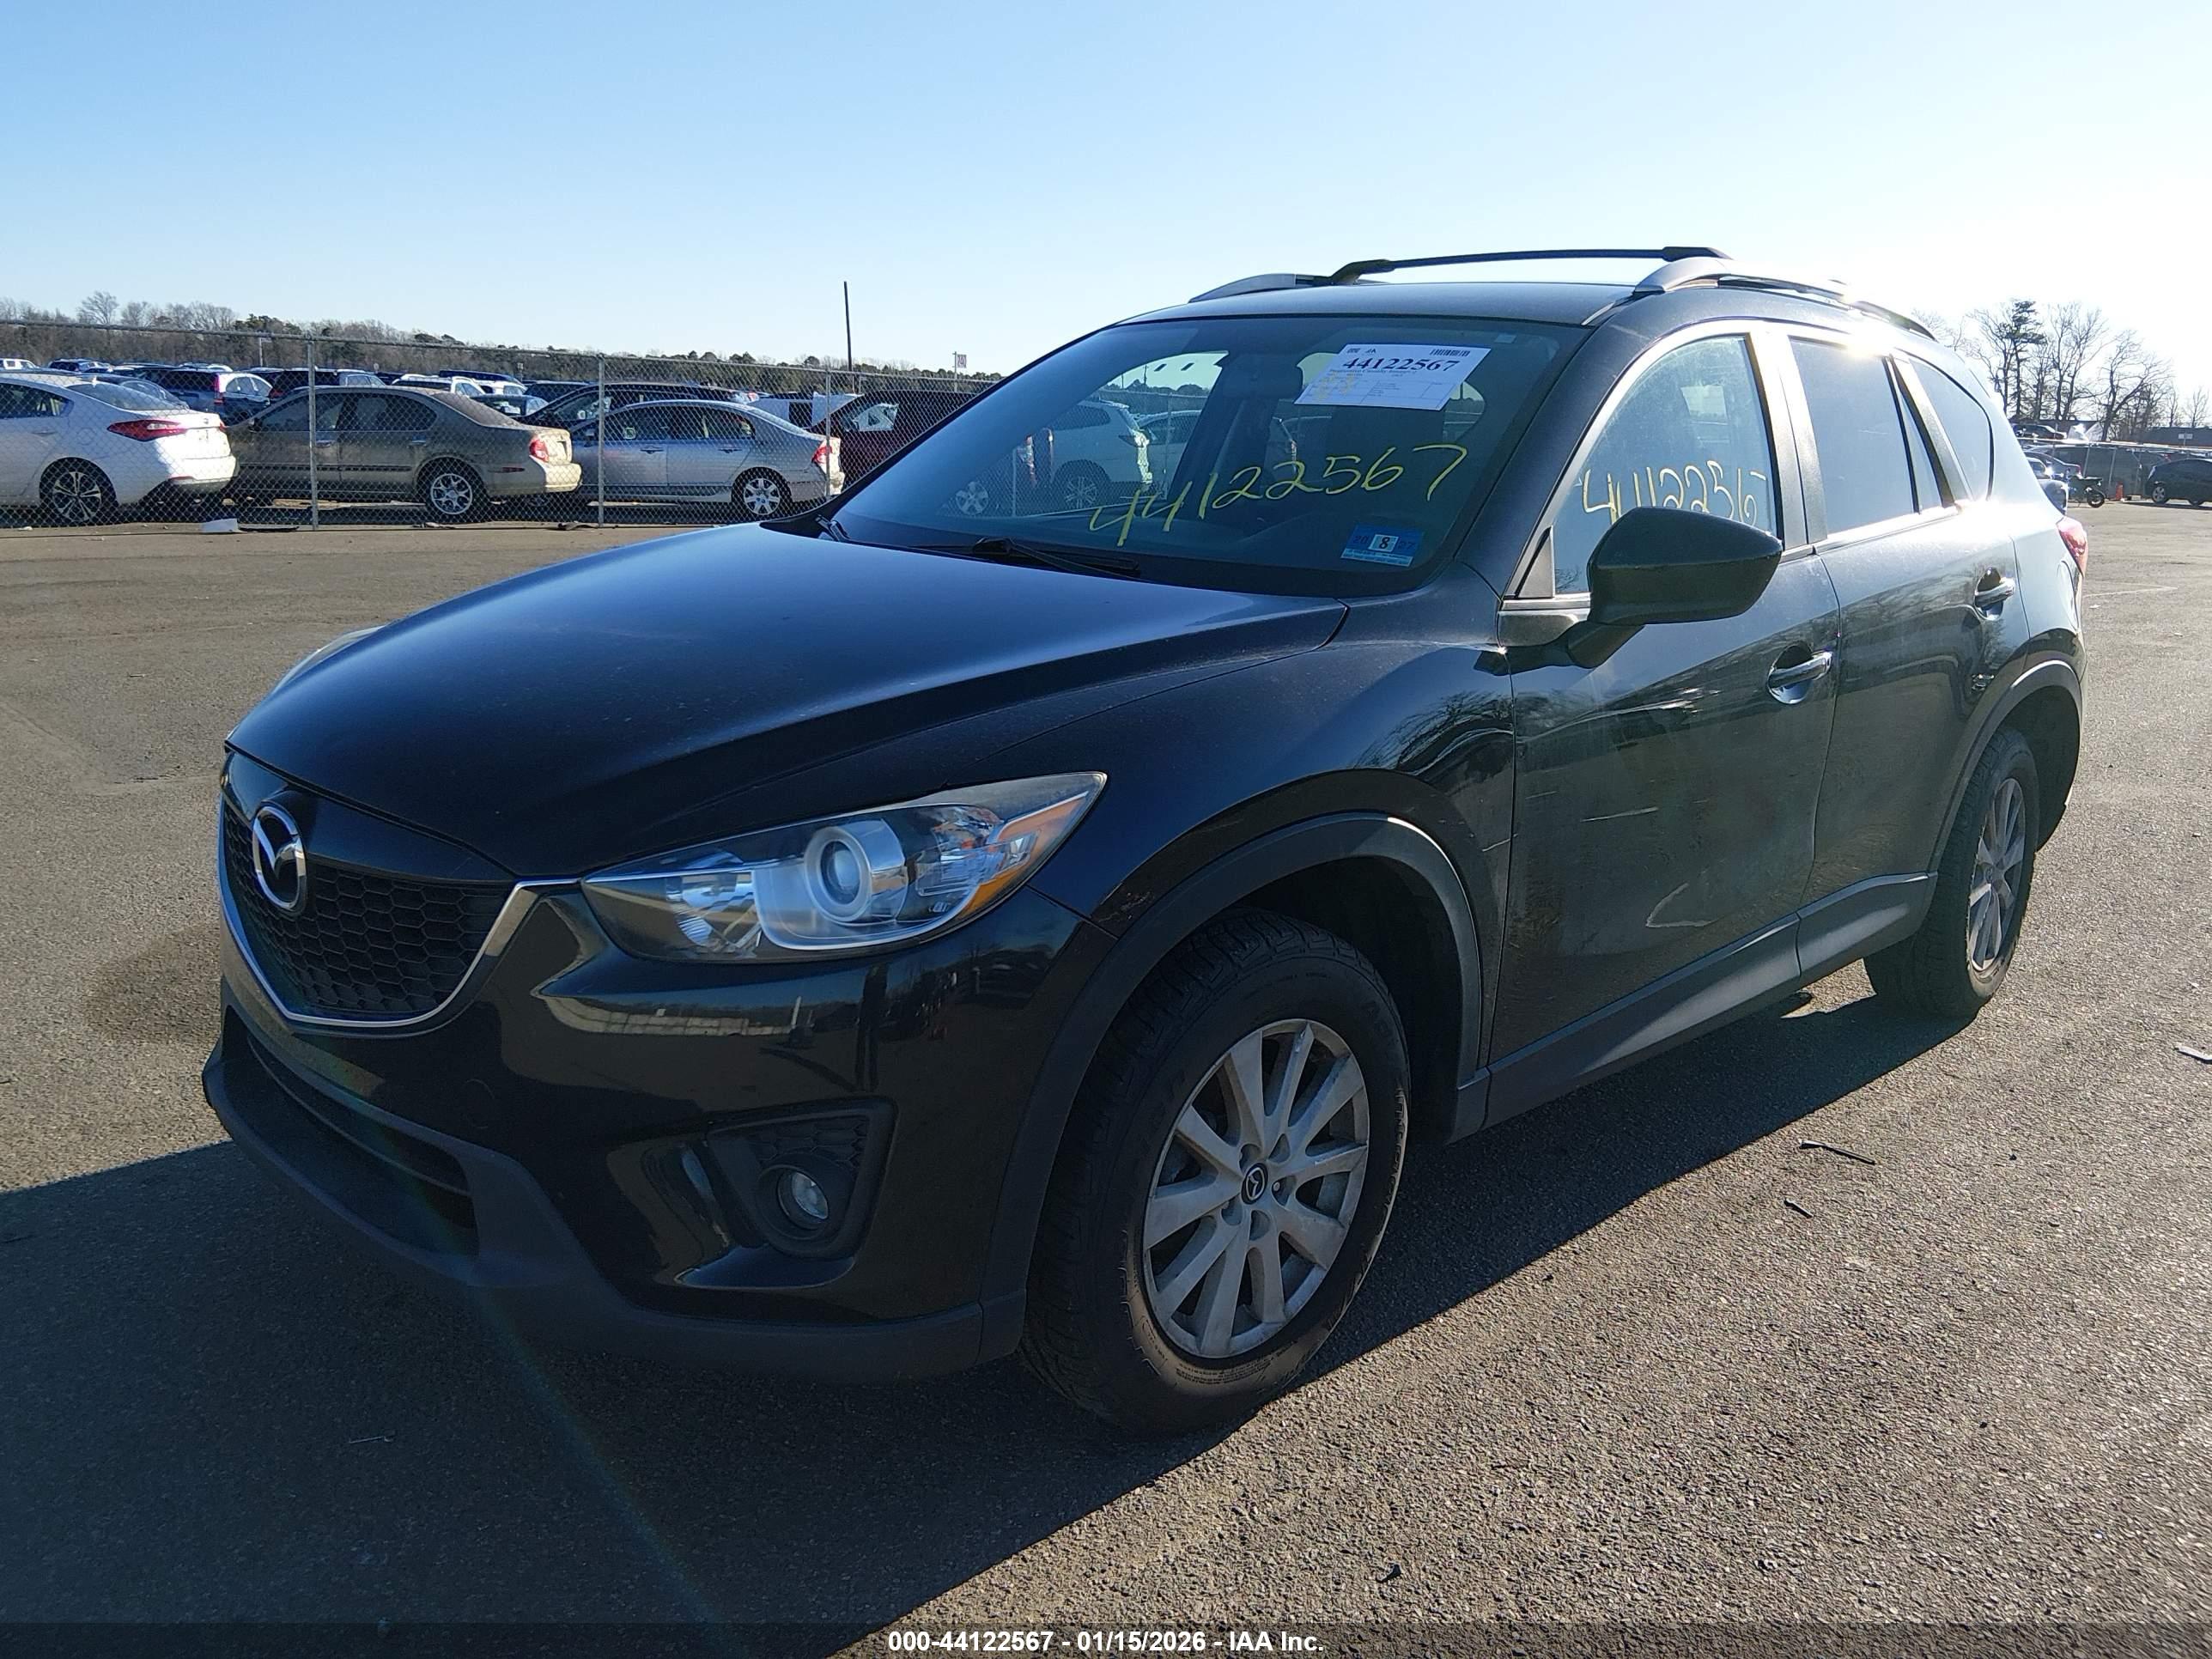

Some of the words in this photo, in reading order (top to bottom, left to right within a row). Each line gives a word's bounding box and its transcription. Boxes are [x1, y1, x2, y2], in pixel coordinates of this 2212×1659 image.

[1342, 357, 1461, 372] 44122567
[1089, 443, 1468, 547] 44122567
[1380, 537, 1390, 549] 8
